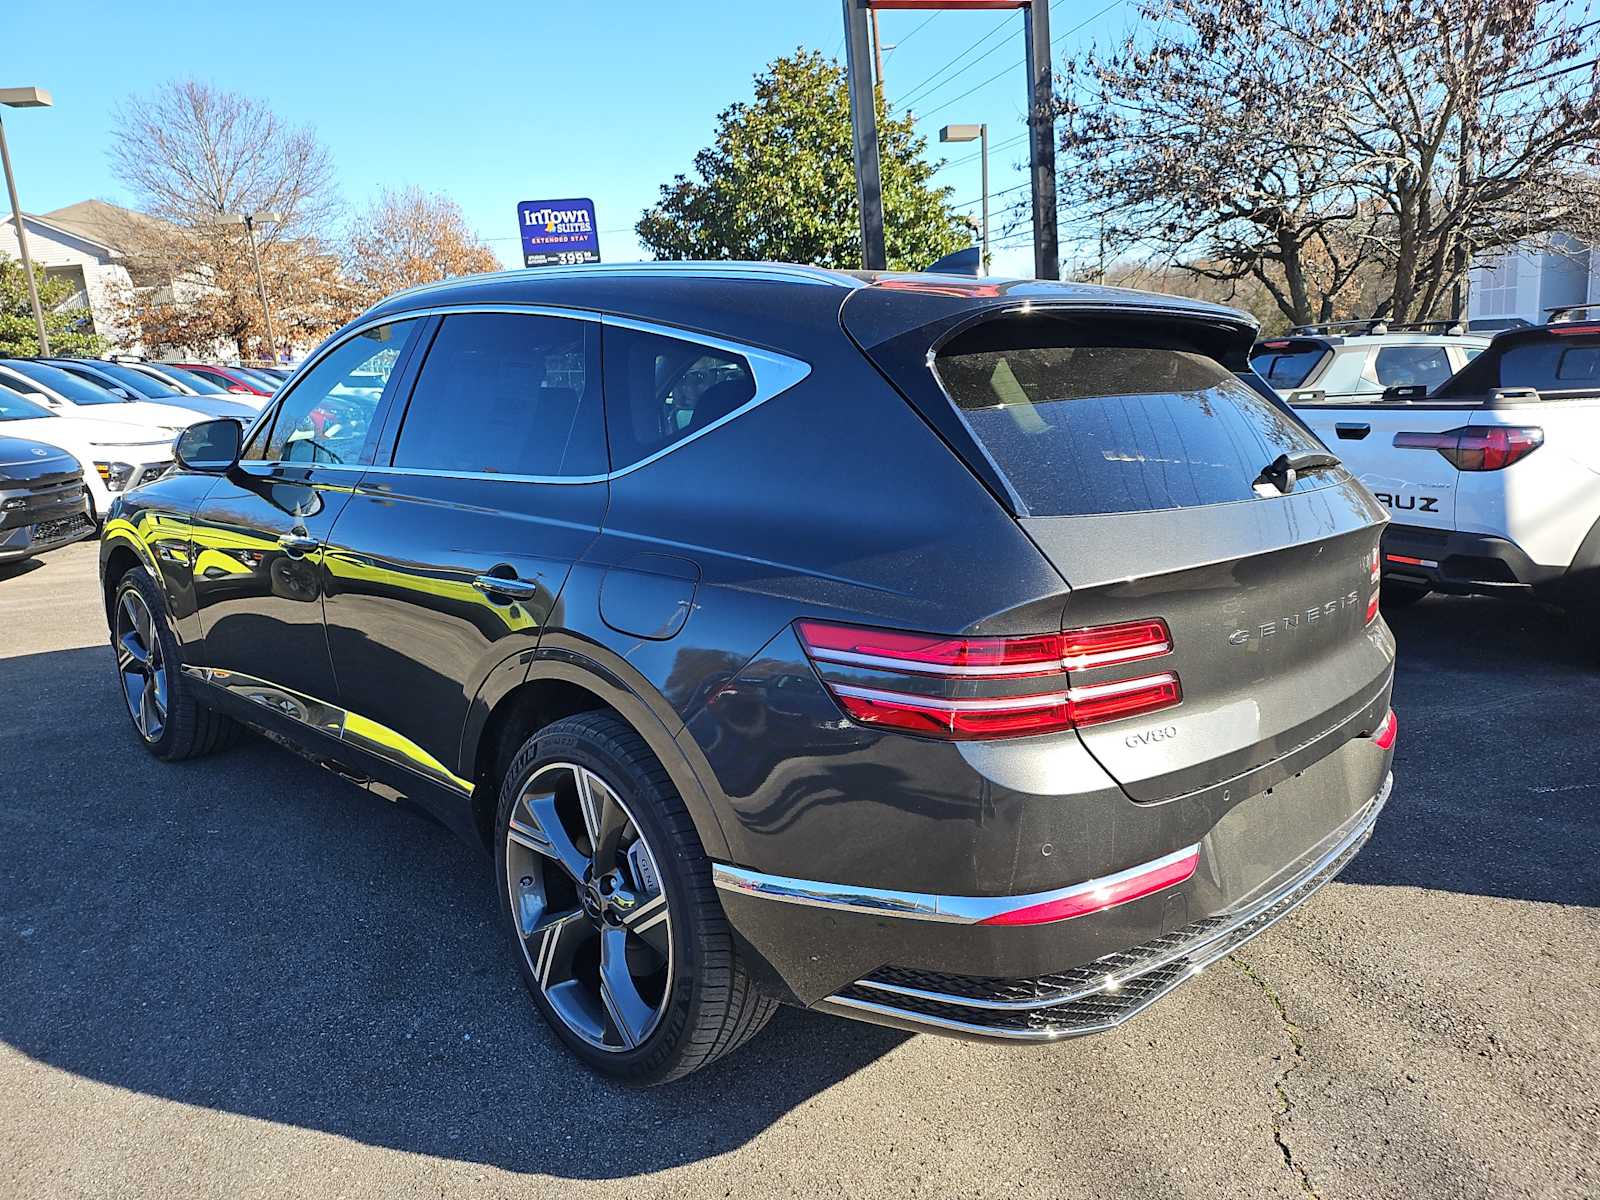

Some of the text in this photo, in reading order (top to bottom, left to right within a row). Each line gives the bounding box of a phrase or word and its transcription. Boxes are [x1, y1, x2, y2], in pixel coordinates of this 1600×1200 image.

[523, 209, 590, 225] InTown
[1374, 492, 1440, 513] RUZ
[1228, 590, 1359, 646] GENESIS
[1124, 726, 1177, 749] GV80
